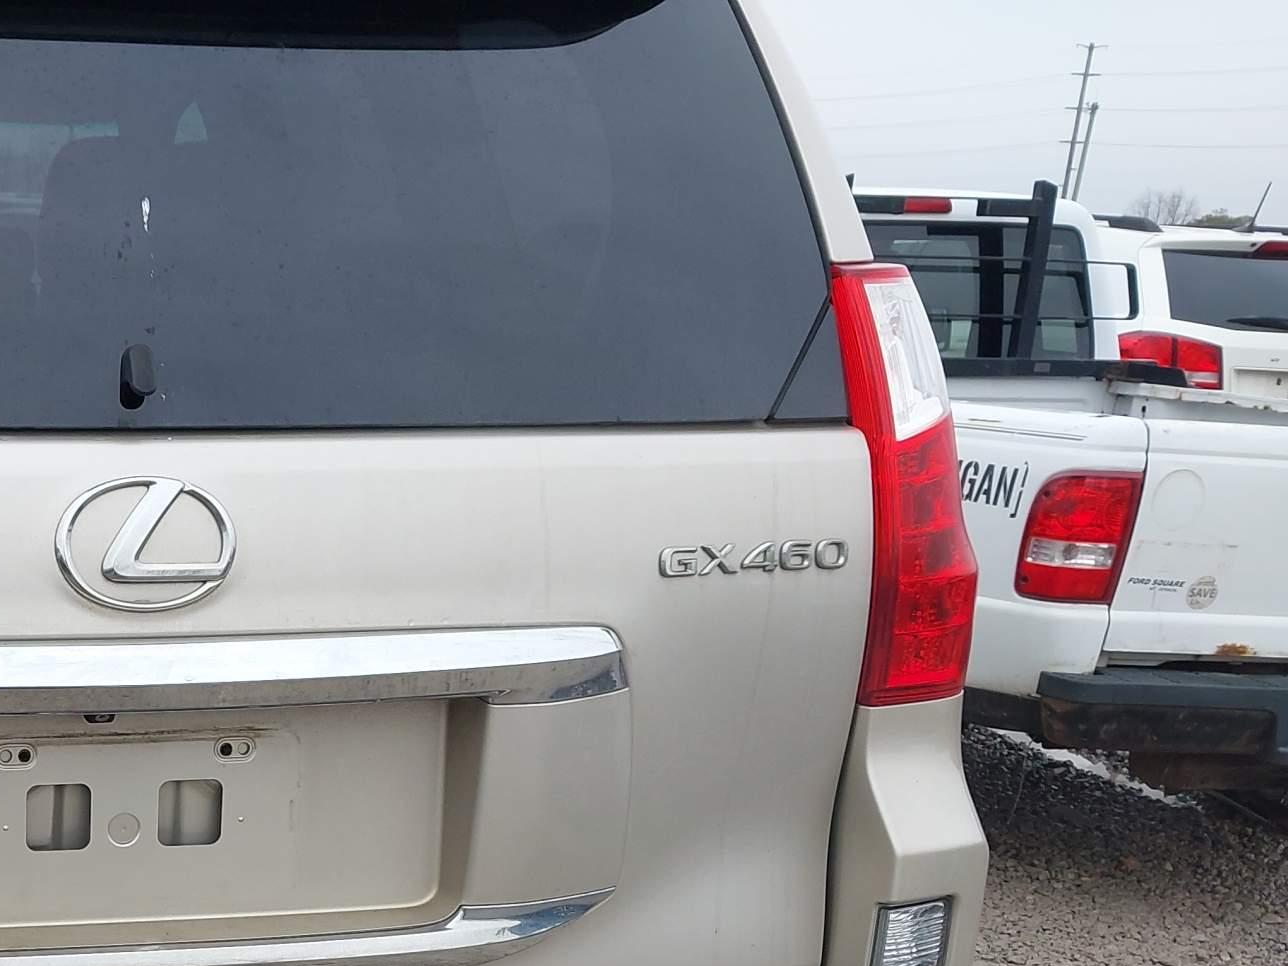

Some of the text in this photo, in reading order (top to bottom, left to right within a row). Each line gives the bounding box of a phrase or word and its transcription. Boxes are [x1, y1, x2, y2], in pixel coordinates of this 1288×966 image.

[1127, 577, 1186, 588] FORD SQUARE
[1188, 587, 1217, 599] SAVE
